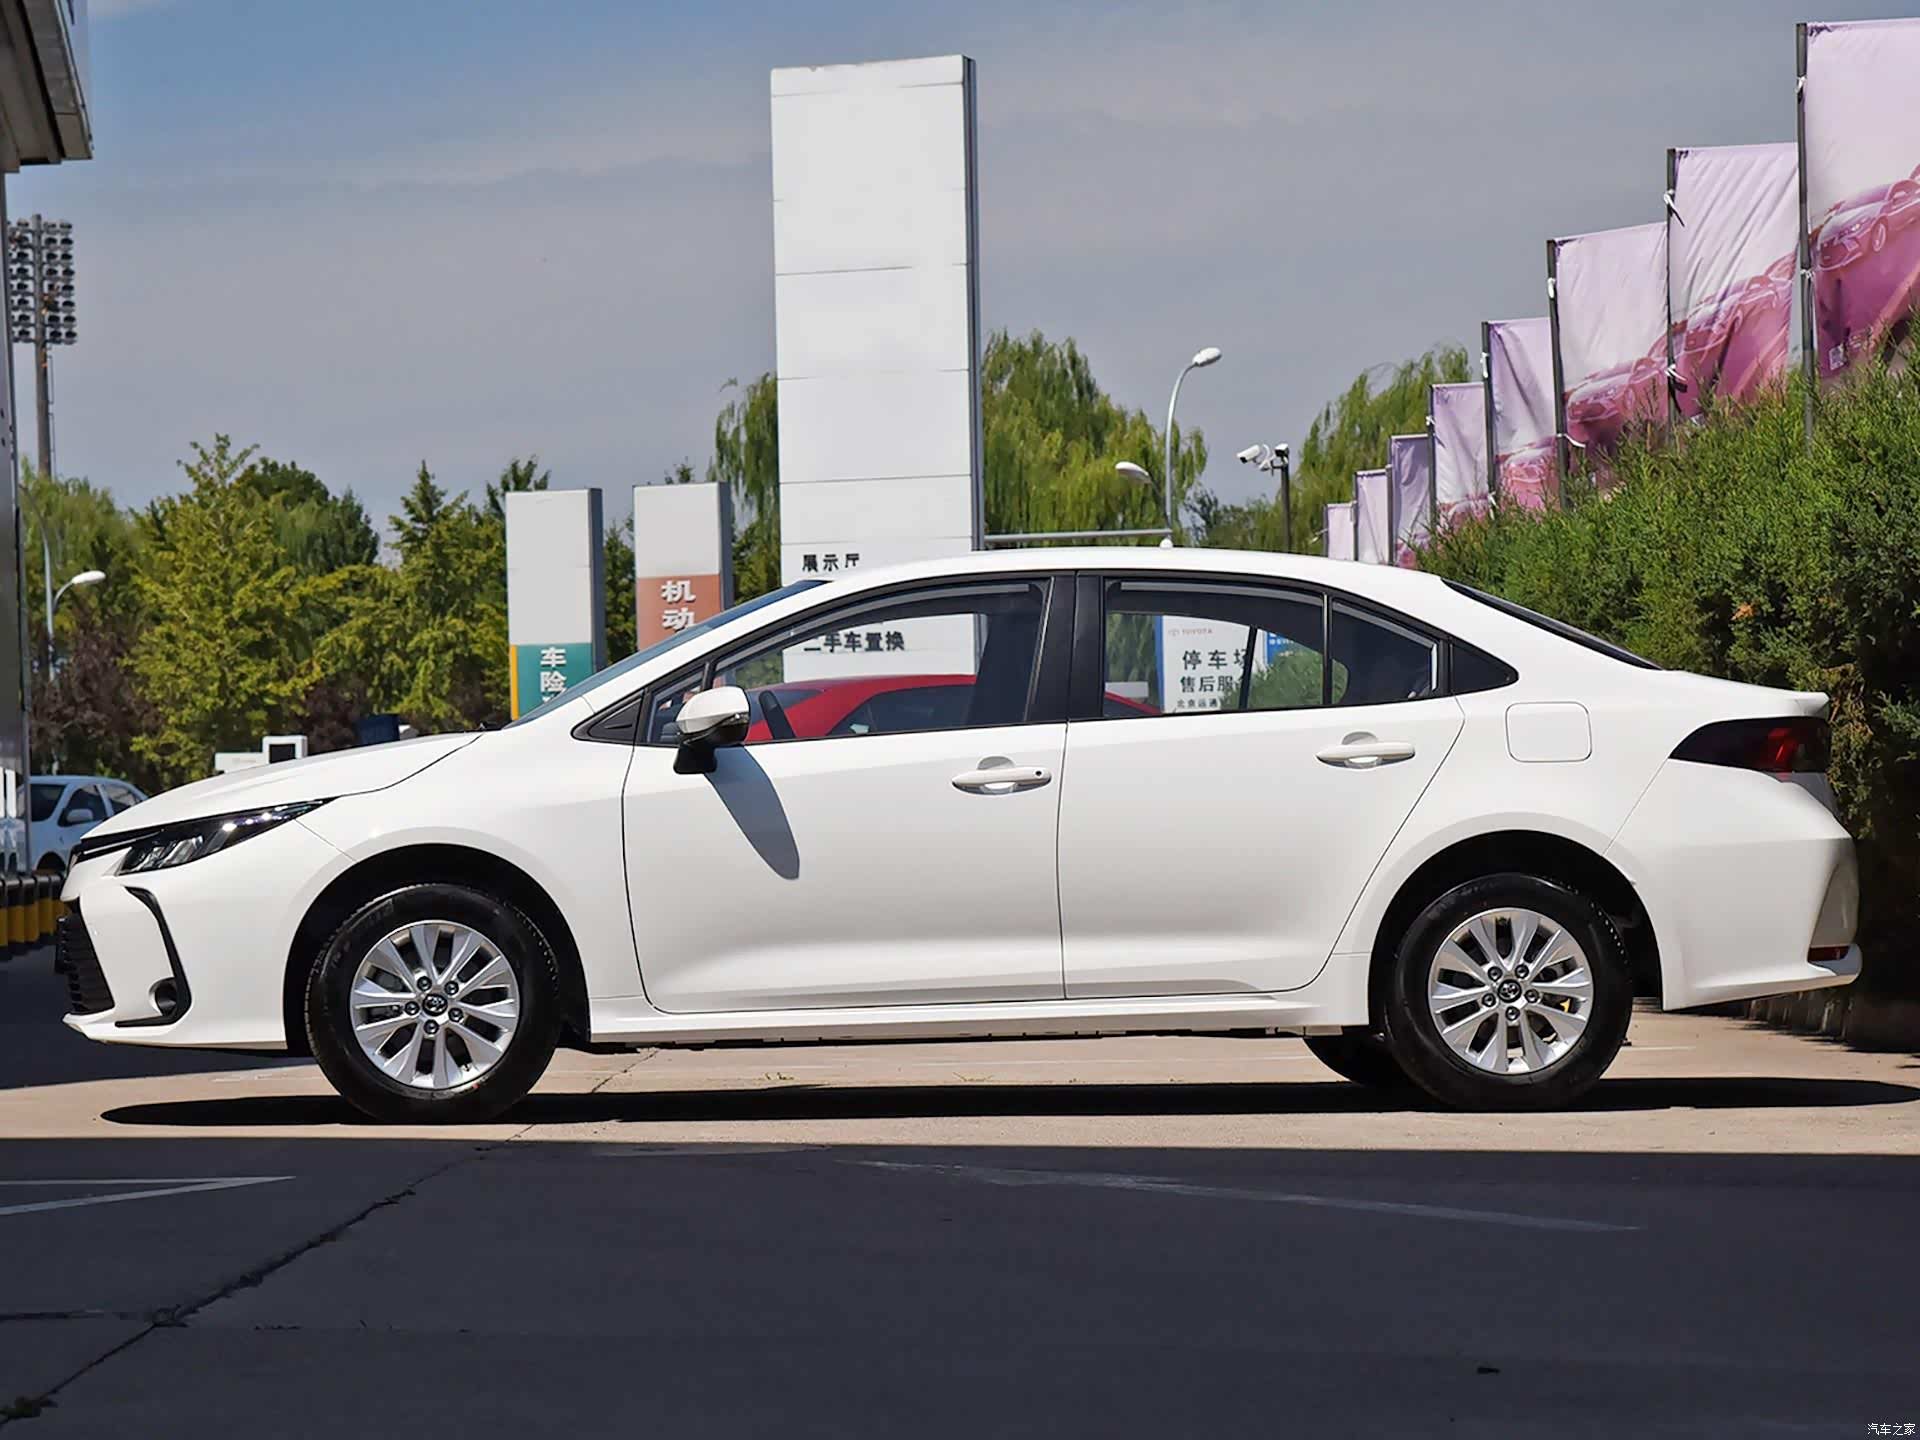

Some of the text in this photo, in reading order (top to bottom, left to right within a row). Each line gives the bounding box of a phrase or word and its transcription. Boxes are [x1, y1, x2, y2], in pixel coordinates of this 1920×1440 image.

[802, 552, 860, 572] 展示厅
[540, 647, 567, 702] 车险
